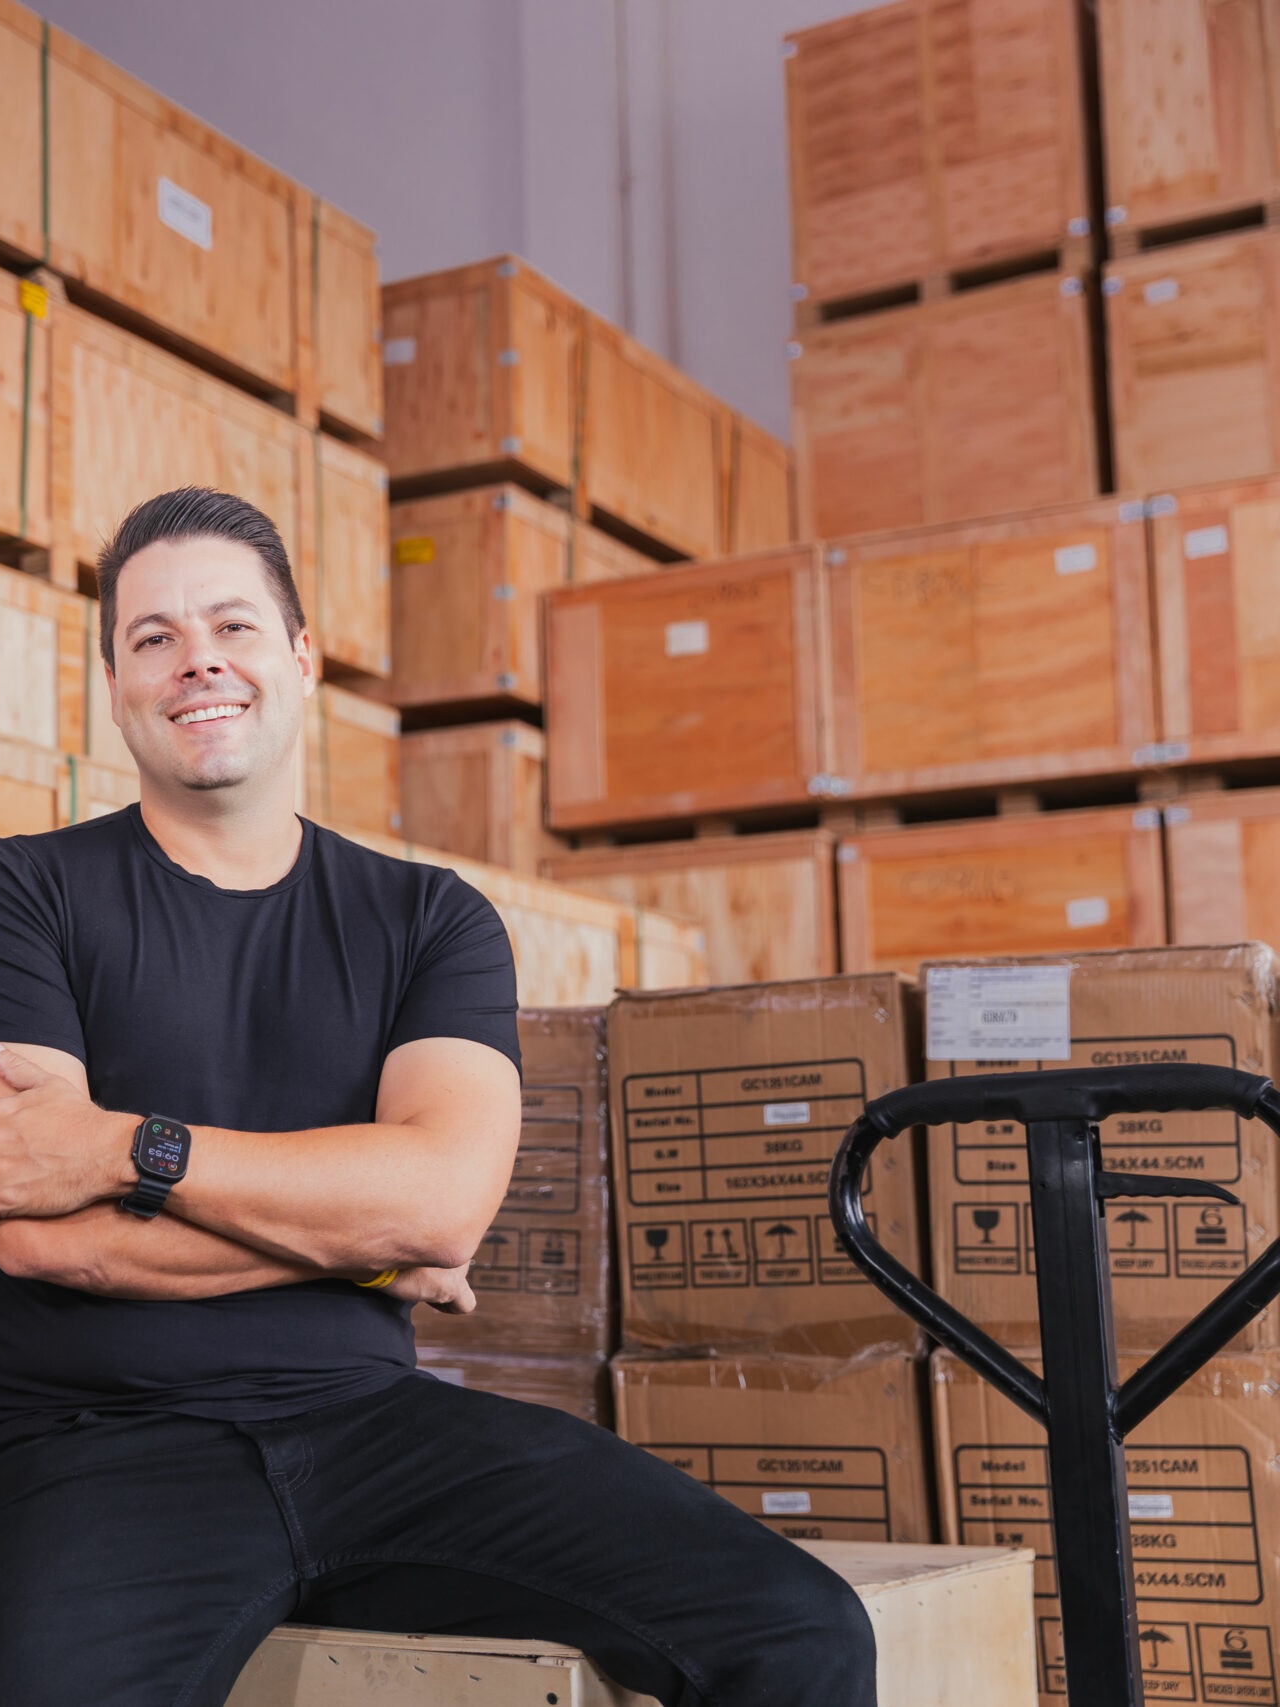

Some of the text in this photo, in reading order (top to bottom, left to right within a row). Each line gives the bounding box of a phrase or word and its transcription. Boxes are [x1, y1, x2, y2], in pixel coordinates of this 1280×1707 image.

[1091, 1049, 1188, 1066] GC1351CAM
[741, 1074, 822, 1092] GC1351CAM
[644, 1086, 683, 1099] Model
[634, 1116, 696, 1128] Serial No.
[1117, 1120, 1163, 1134] 38KG
[764, 1140, 803, 1155] 38KG
[987, 1160, 1017, 1171] Size
[725, 1170, 830, 1190] 163X34X44.5C
[1200, 1206, 1223, 1228] 6
[756, 1458, 844, 1473] GC1351CAM
[981, 1461, 1026, 1472] Model
[1126, 1458, 1199, 1473] 1351CAM
[970, 1494, 1044, 1507] Serial No.
[1131, 1533, 1177, 1549] 38KG
[1134, 1572, 1227, 1588] 4X44.5CM
[1223, 1628, 1248, 1651] 6
